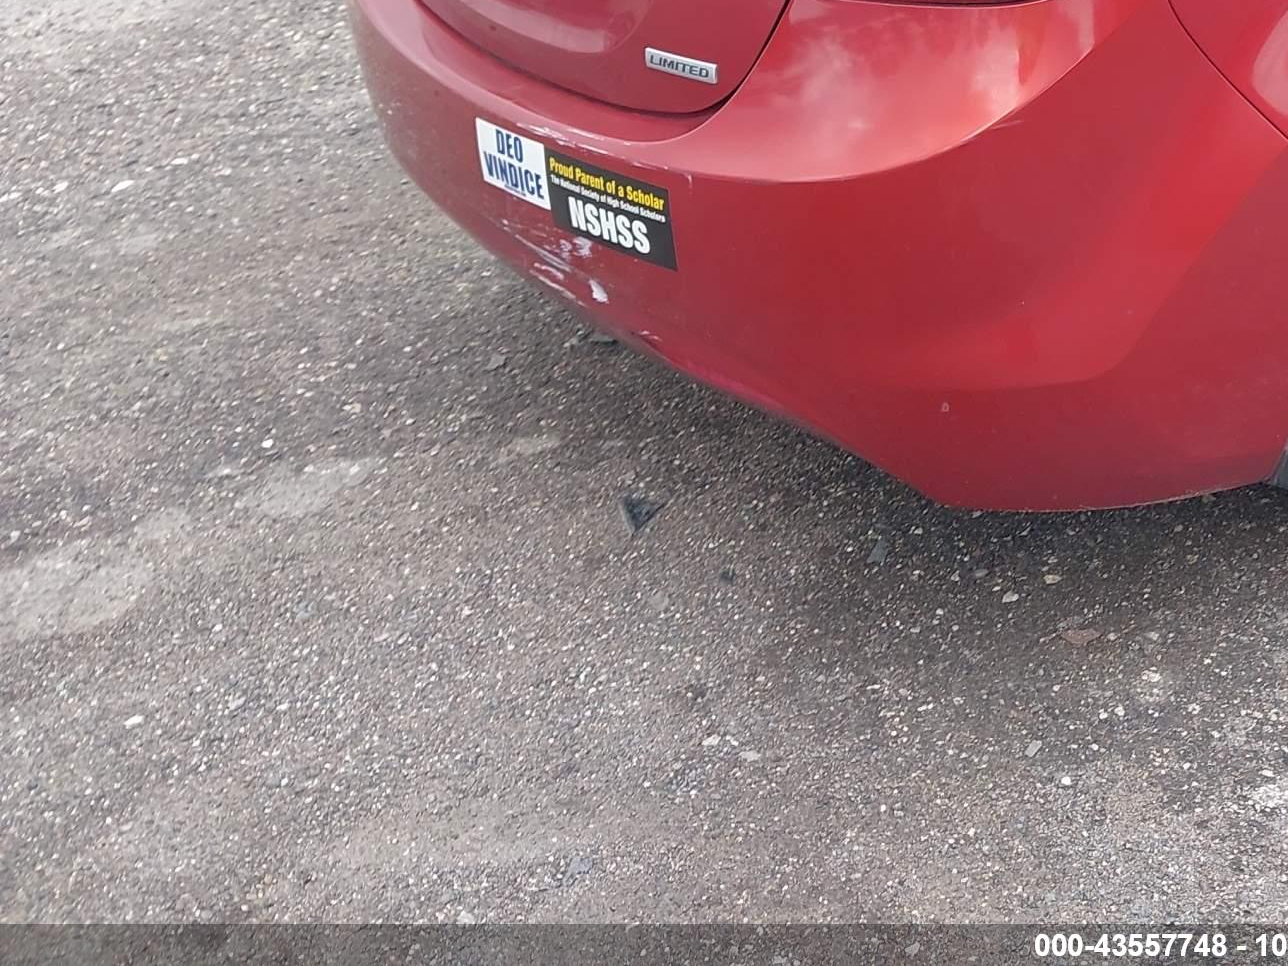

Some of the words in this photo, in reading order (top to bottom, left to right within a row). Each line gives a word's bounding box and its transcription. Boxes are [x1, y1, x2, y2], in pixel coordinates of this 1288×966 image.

[649, 54, 710, 78] LIMITED
[495, 128, 524, 163] DEO
[483, 150, 545, 200] VINDICE
[549, 157, 574, 179] Proud
[575, 169, 604, 191] Parent
[606, 181, 616, 194] of
[617, 186, 625, 197] a
[626, 186, 665, 211] Scholar
[568, 196, 651, 254] NSHSS
